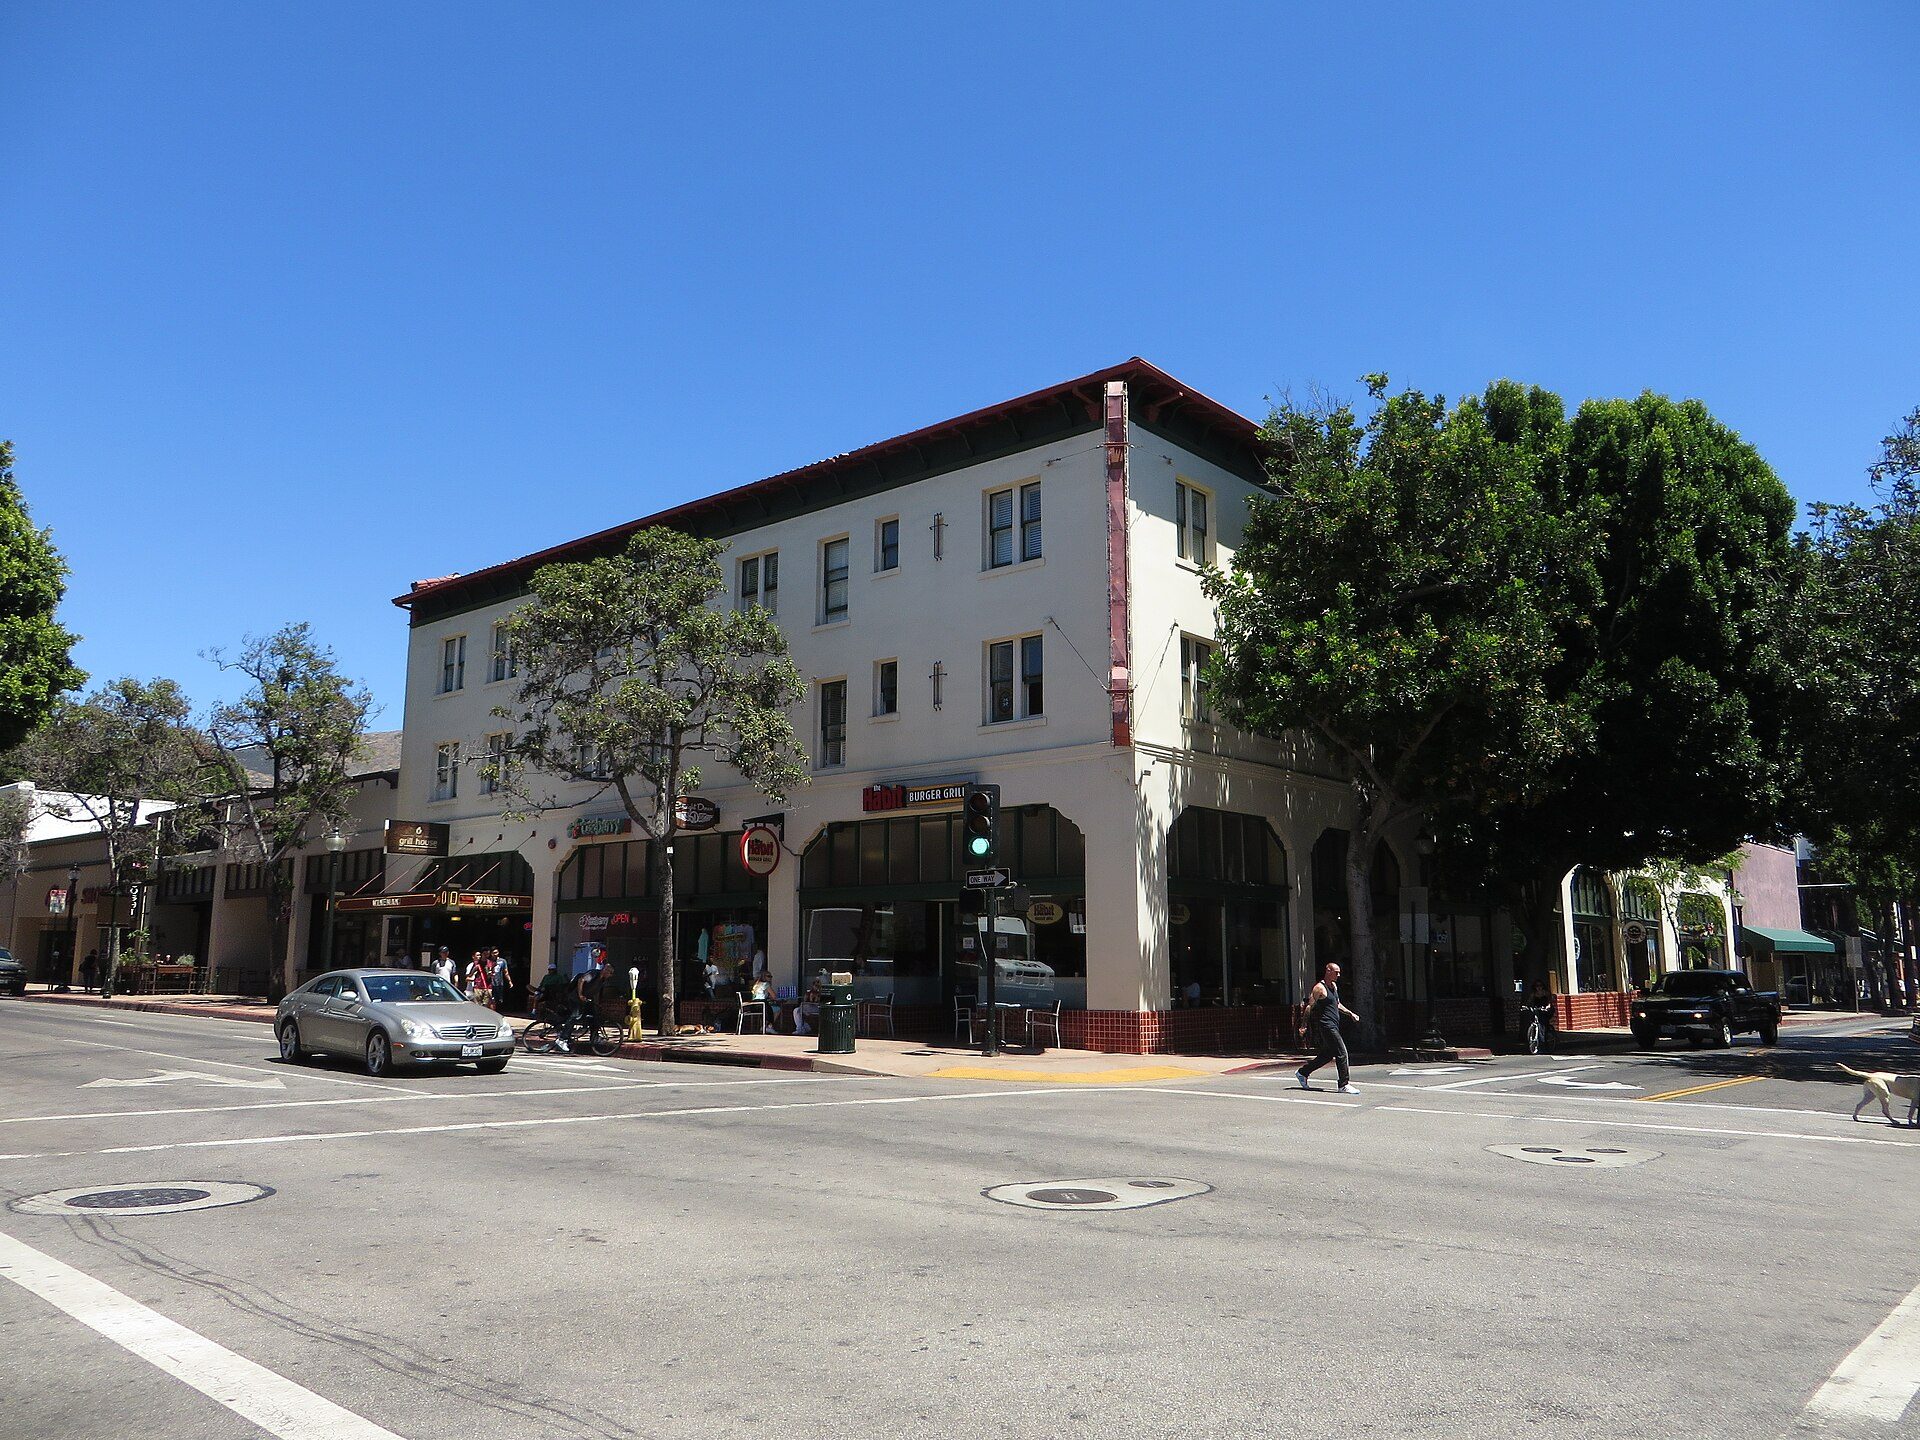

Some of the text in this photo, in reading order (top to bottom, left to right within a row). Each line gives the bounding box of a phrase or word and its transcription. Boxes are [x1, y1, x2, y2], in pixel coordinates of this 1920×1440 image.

[909, 789, 941, 802] BURGER
[399, 837, 438, 847] grill house
[970, 874, 995, 884] ONE WAY
[474, 895, 520, 906] WINEMAN
